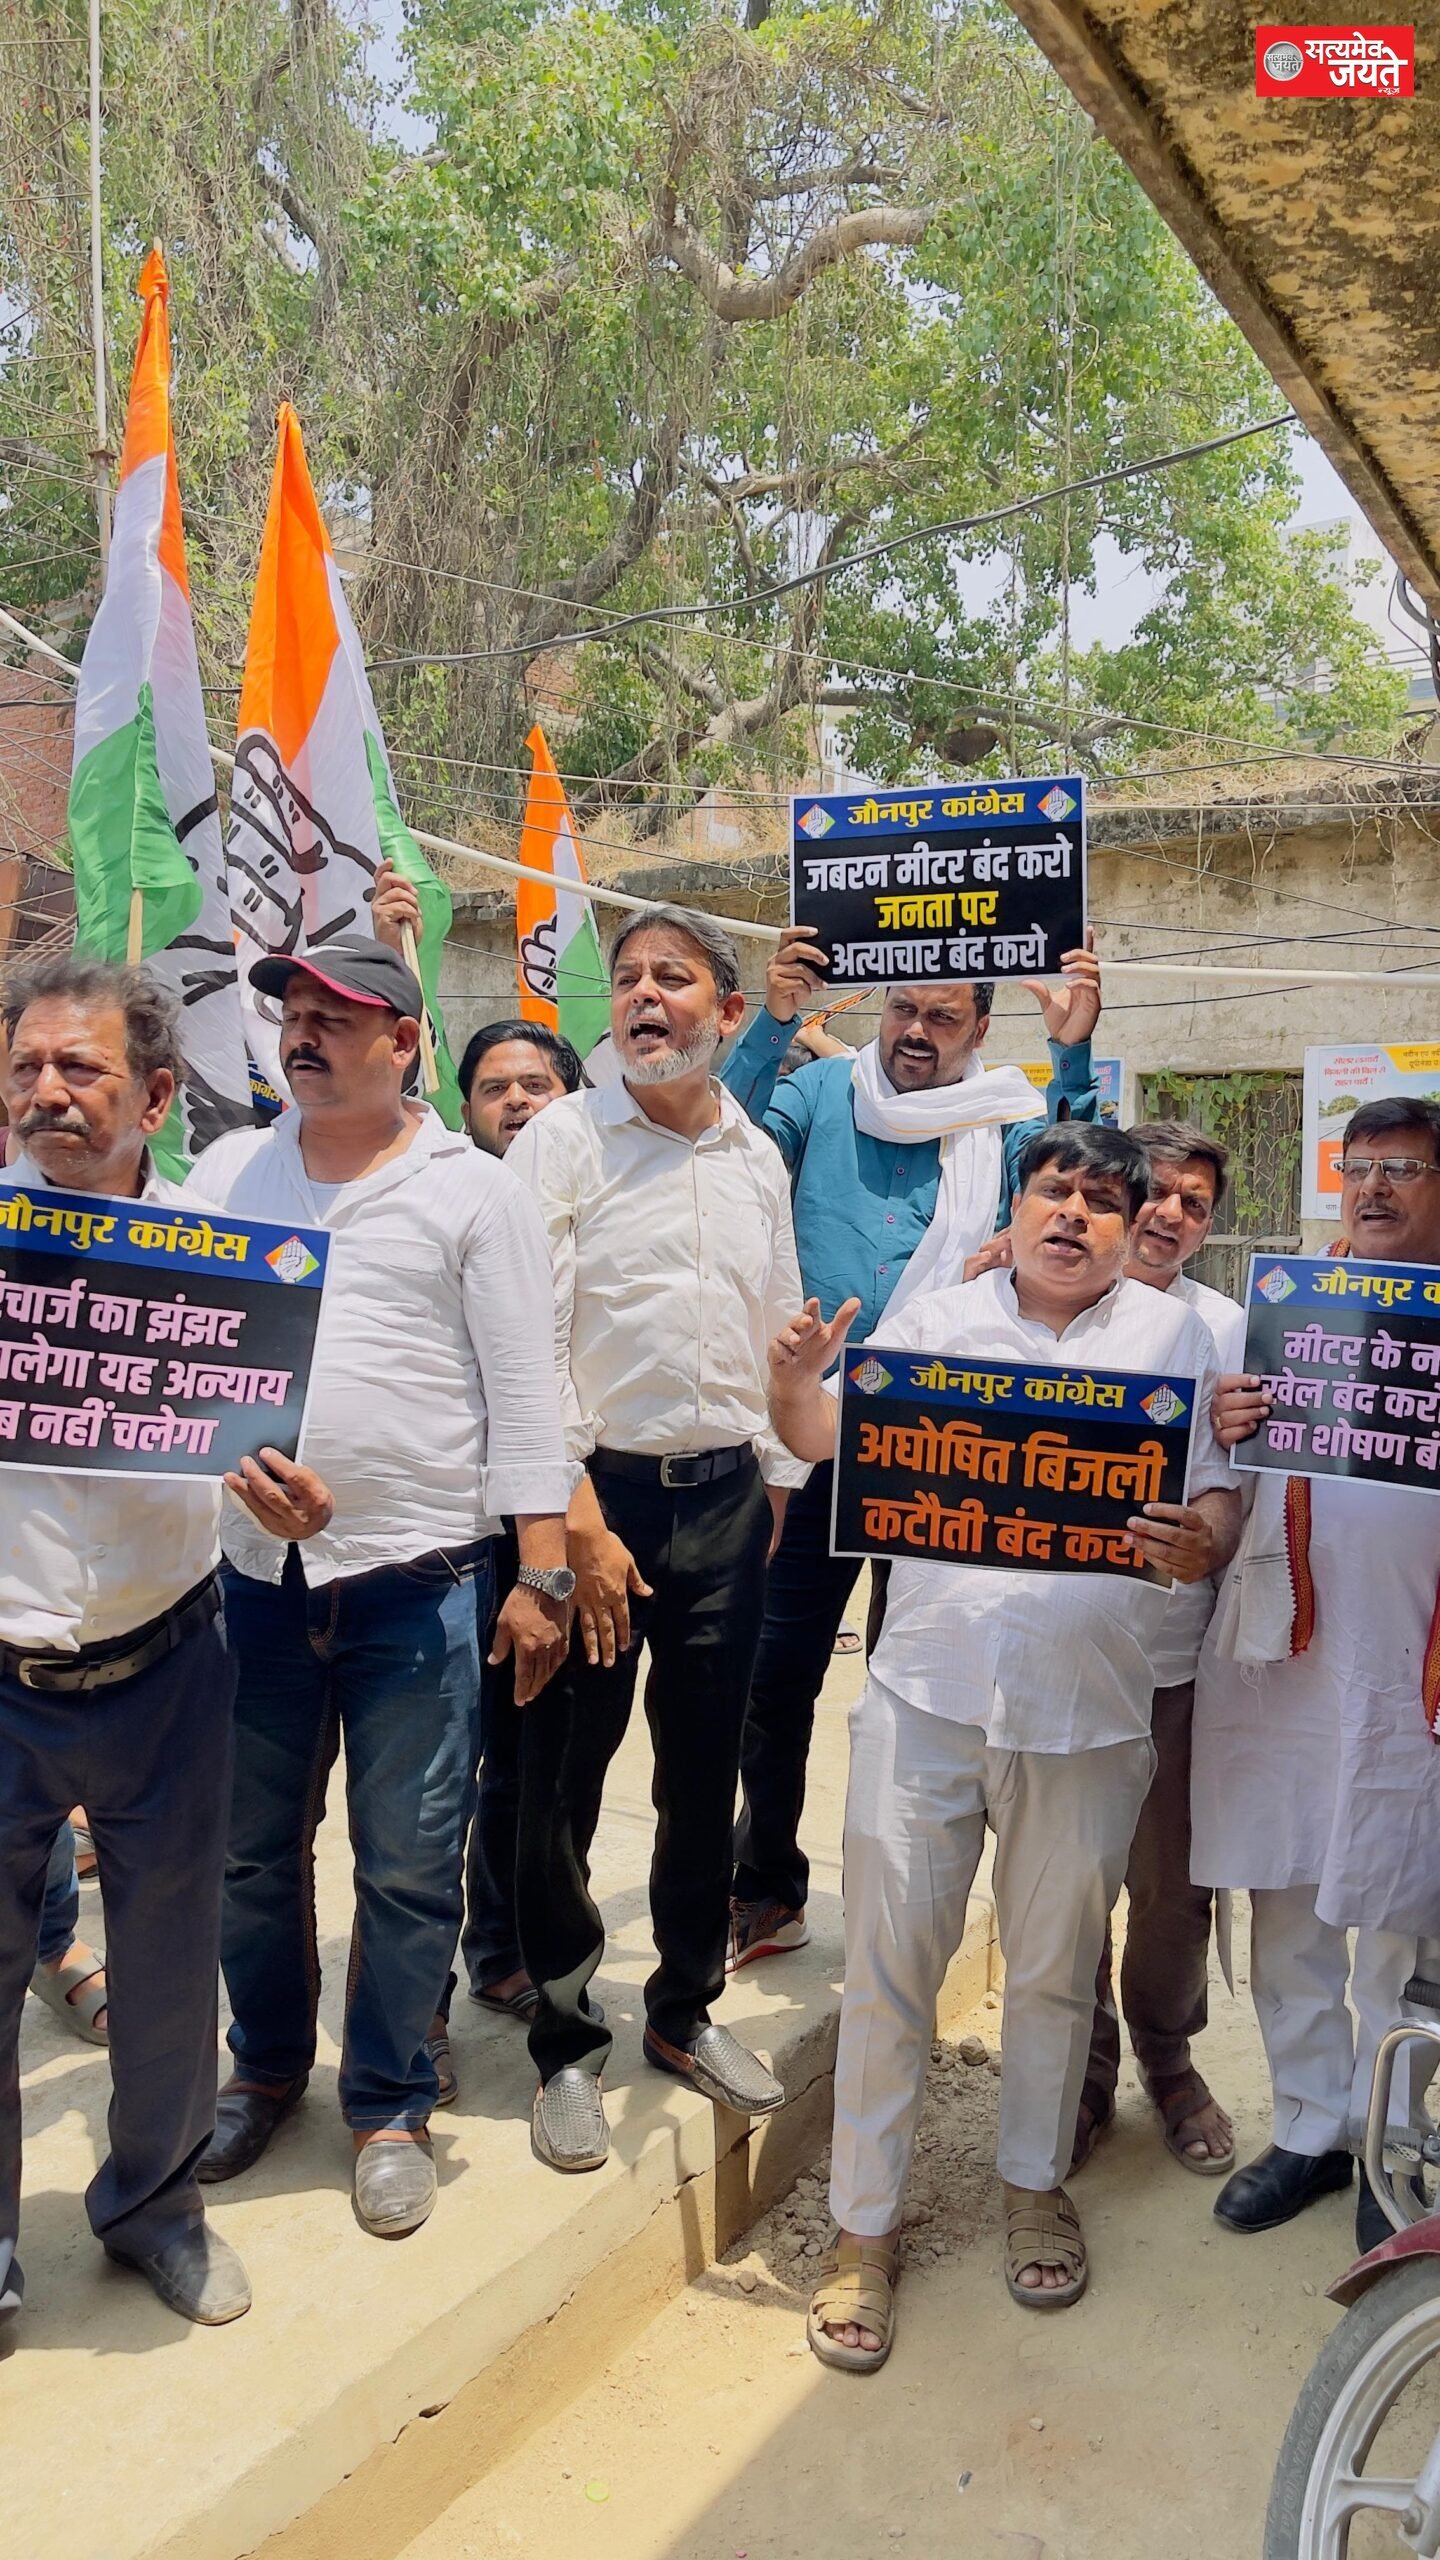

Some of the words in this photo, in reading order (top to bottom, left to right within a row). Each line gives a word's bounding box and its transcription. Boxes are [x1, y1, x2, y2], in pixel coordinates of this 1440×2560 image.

[848, 798, 933, 827] जौनपुर
[941, 789, 1025, 817] कांग्रेस
[803, 854, 891, 892] जबरन
[894, 841, 967, 886] मीटर
[970, 838, 1012, 881] बंद
[1015, 832, 1073, 879] करो
[874, 893, 955, 930] जनता
[958, 890, 999, 926] पर
[831, 939, 942, 977] अत्याचार
[946, 928, 988, 971] बंद
[991, 923, 1048, 969] करो
[128, 1217, 250, 1262] कांग्रेस
[0, 1269, 87, 1329] चार्ज
[88, 1293, 143, 1336] का
[145, 1293, 247, 1348] झंझट
[1312, 1266, 1415, 1307] जौनपुर
[1283, 1323, 1366, 1366] मीटर
[1370, 1329, 1407, 1370] के
[98, 1352, 159, 1396] यह
[162, 1360, 294, 1407] अन्याय
[910, 1360, 1015, 1404] जौनपुर
[1024, 1374, 1126, 1409] कांग्रेस
[1332, 1373, 1380, 1414] बंद
[29, 1397, 117, 1448] नहीं
[111, 1404, 220, 1455] चलेगा
[1267, 1419, 1306, 1453] का
[1311, 1417, 1410, 1466] शोषण
[1414, 1430, 1440, 1470] बं
[857, 1416, 1016, 1484] अघोषित
[1022, 1430, 1168, 1502] बिजली
[862, 1490, 988, 1553] कटौती
[994, 1506, 1057, 1559] बंद
